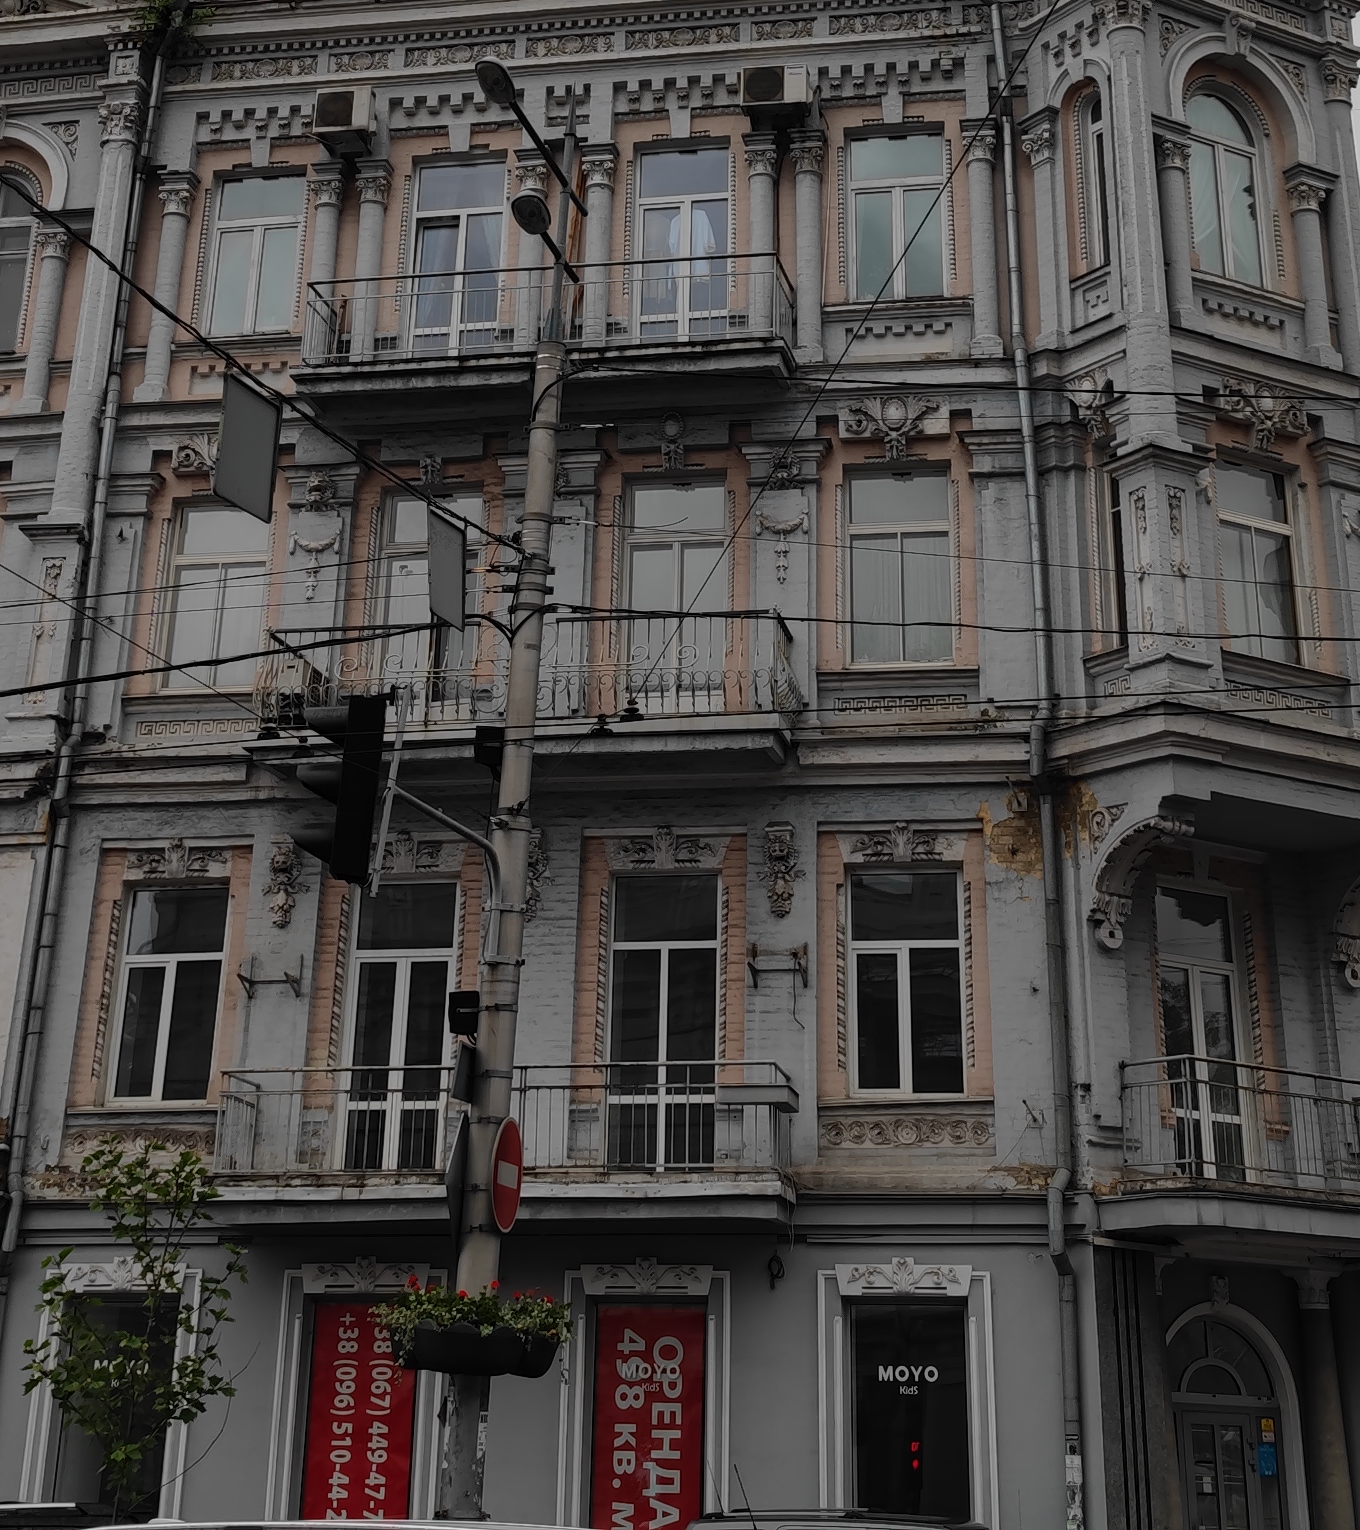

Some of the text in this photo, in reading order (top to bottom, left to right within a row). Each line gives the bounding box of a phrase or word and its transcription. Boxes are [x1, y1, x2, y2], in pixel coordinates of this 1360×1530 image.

[337, 1312, 360, 1354] +38
[329, 1359, 359, 1416] (096)
[365, 1359, 394, 1416] (067)
[622, 1362, 680, 1380] MOYO
[878, 1365, 939, 1382] MOYO
[642, 1336, 684, 1530] ОРЕНДА
